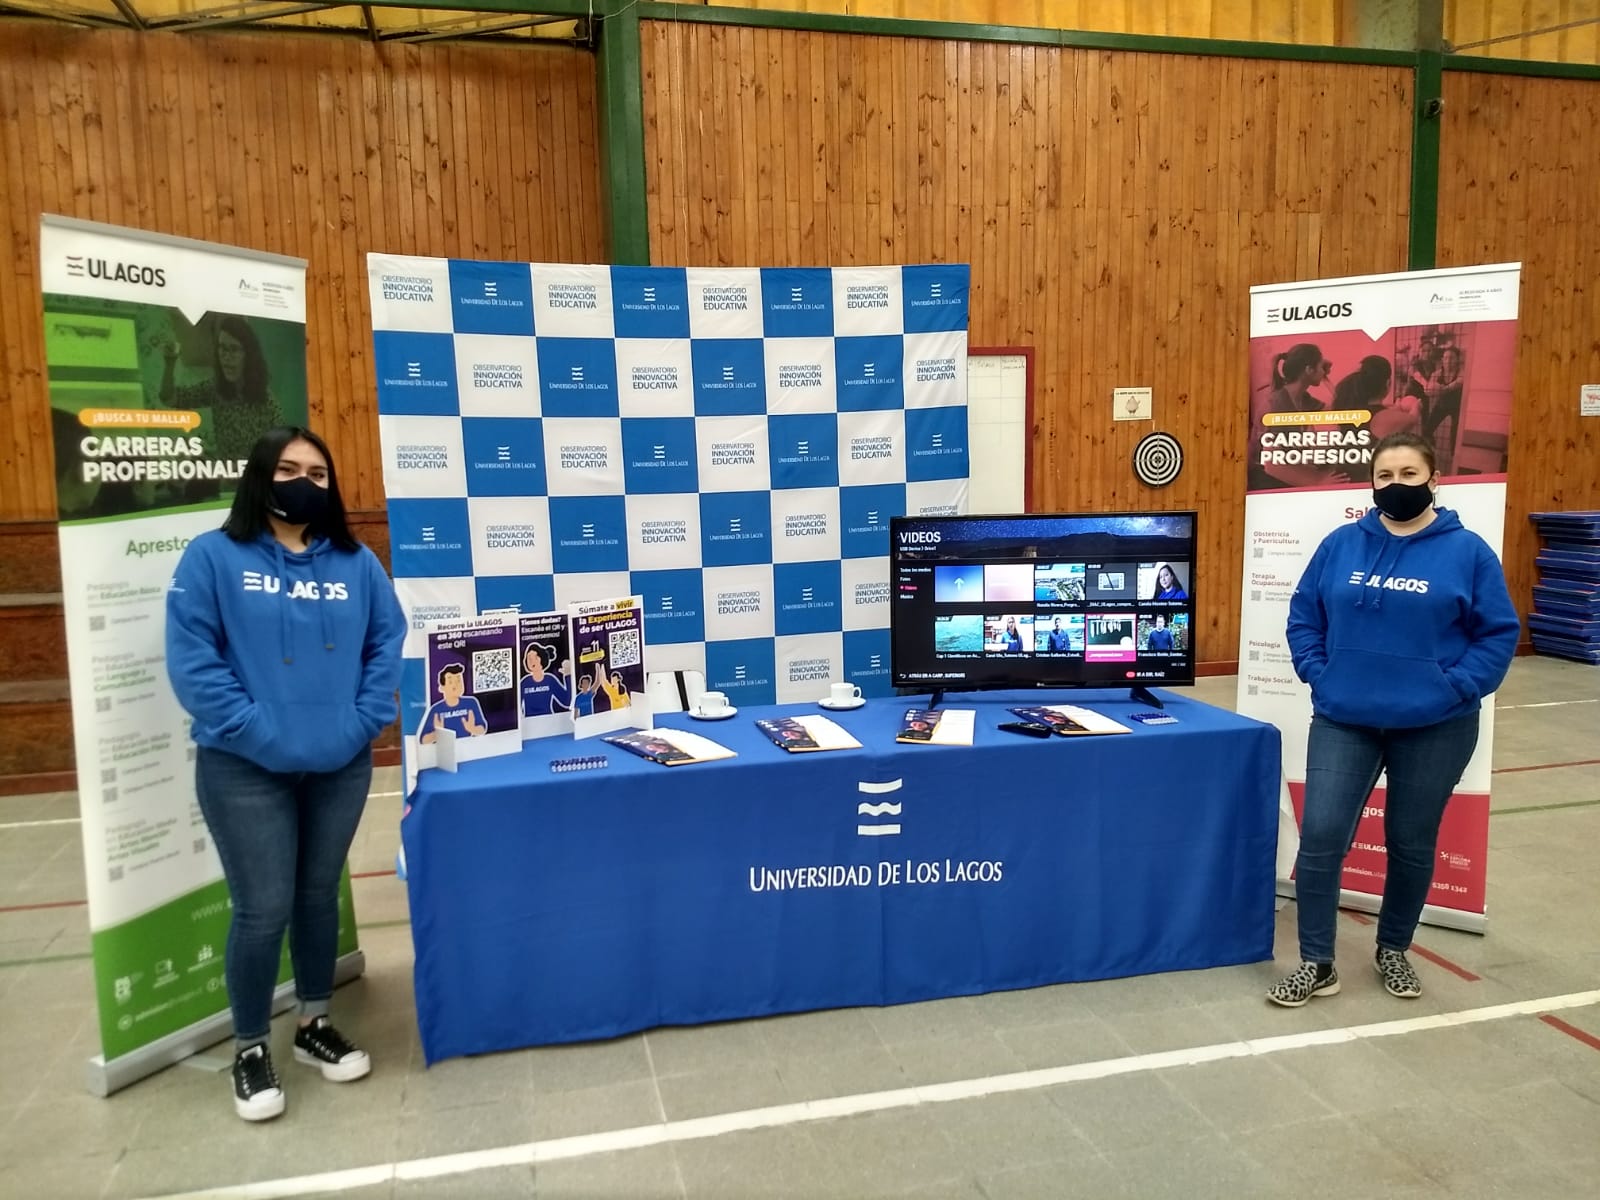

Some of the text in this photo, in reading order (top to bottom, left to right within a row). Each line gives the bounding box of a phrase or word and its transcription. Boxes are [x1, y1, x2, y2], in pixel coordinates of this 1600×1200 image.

[88, 258, 166, 287] ULAGOS
[382, 283, 433, 292] INNOVACIÓN
[384, 292, 433, 302] EDUCATIVA
[549, 292, 596, 300] INNOVACIÓN
[704, 294, 747, 302] INNOVACIÓN
[847, 292, 888, 300] INNOVACIÓN
[550, 300, 596, 308] EDUCATIVA
[704, 302, 747, 310] EDUCATIVA
[848, 300, 888, 308] EDUCATIVA
[1282, 302, 1352, 322] ULAGOS
[917, 365, 956, 374] INNOVACIÓN
[474, 372, 522, 380] INNOVACIÓN
[632, 374, 678, 382] INNOVACIÓN
[780, 371, 822, 379] INNOVACIÓN
[917, 372, 956, 382] EDUCATIVA
[474, 380, 522, 388] EDUCATIVA
[633, 382, 678, 390] EDUCATIVA
[780, 379, 822, 387] EDUCATIVA
[93, 412, 190, 424] ¡BUSCA TU MALLA!
[1272, 414, 1306, 424] ¡BUSCA
[1326, 412, 1361, 422] MALLA!
[1260, 430, 1370, 448] CARRERAS
[80, 436, 202, 456] CARRERAS
[851, 444, 892, 452] INNOVACIÓN
[397, 452, 448, 460] INNOVACIÓN
[561, 452, 607, 460] INNOVACIÓN
[712, 449, 754, 457] INNOVACIÓN
[852, 451, 892, 460] EDUCATIVA
[1260, 448, 1374, 465] PROFESION
[398, 460, 448, 468] EDUCATIVA
[562, 460, 607, 468] EDUCATIVA
[712, 457, 754, 465] EDUCATIVA
[83, 460, 248, 482] PROFESIONALE
[1345, 507, 1368, 519] Sal
[786, 520, 826, 528] INNOVACIÓN
[487, 531, 534, 540] INNOVACIÓN
[642, 527, 686, 536] INNOVACIÓN
[786, 528, 826, 536] EDUCATIVA
[642, 535, 686, 544] EDUCATIVA
[900, 532, 941, 543] VIDEOS
[488, 540, 534, 548] EDUCATIVA
[264, 577, 348, 600] UAGOS
[856, 588, 890, 597] INNOVACIÓ
[718, 598, 760, 606] INNOVACIÓN
[856, 596, 890, 604] EDUCATIV
[579, 605, 608, 614] Súmate
[616, 600, 633, 608] vivir
[718, 605, 760, 614] EDUCATIVA
[475, 618, 502, 626] ULAGOS
[588, 612, 632, 624] Experiencia
[605, 618, 636, 630] ULAGOS
[448, 632, 462, 640] 360
[789, 664, 830, 674] INNOVACIÓN
[790, 672, 830, 681] EDUCATIVA
[1248, 674, 1272, 683] Trabajo
[1364, 844, 1386, 852] ULAGO
[750, 858, 1002, 892] UNIVERSIDAD DE LOS LAGOS
